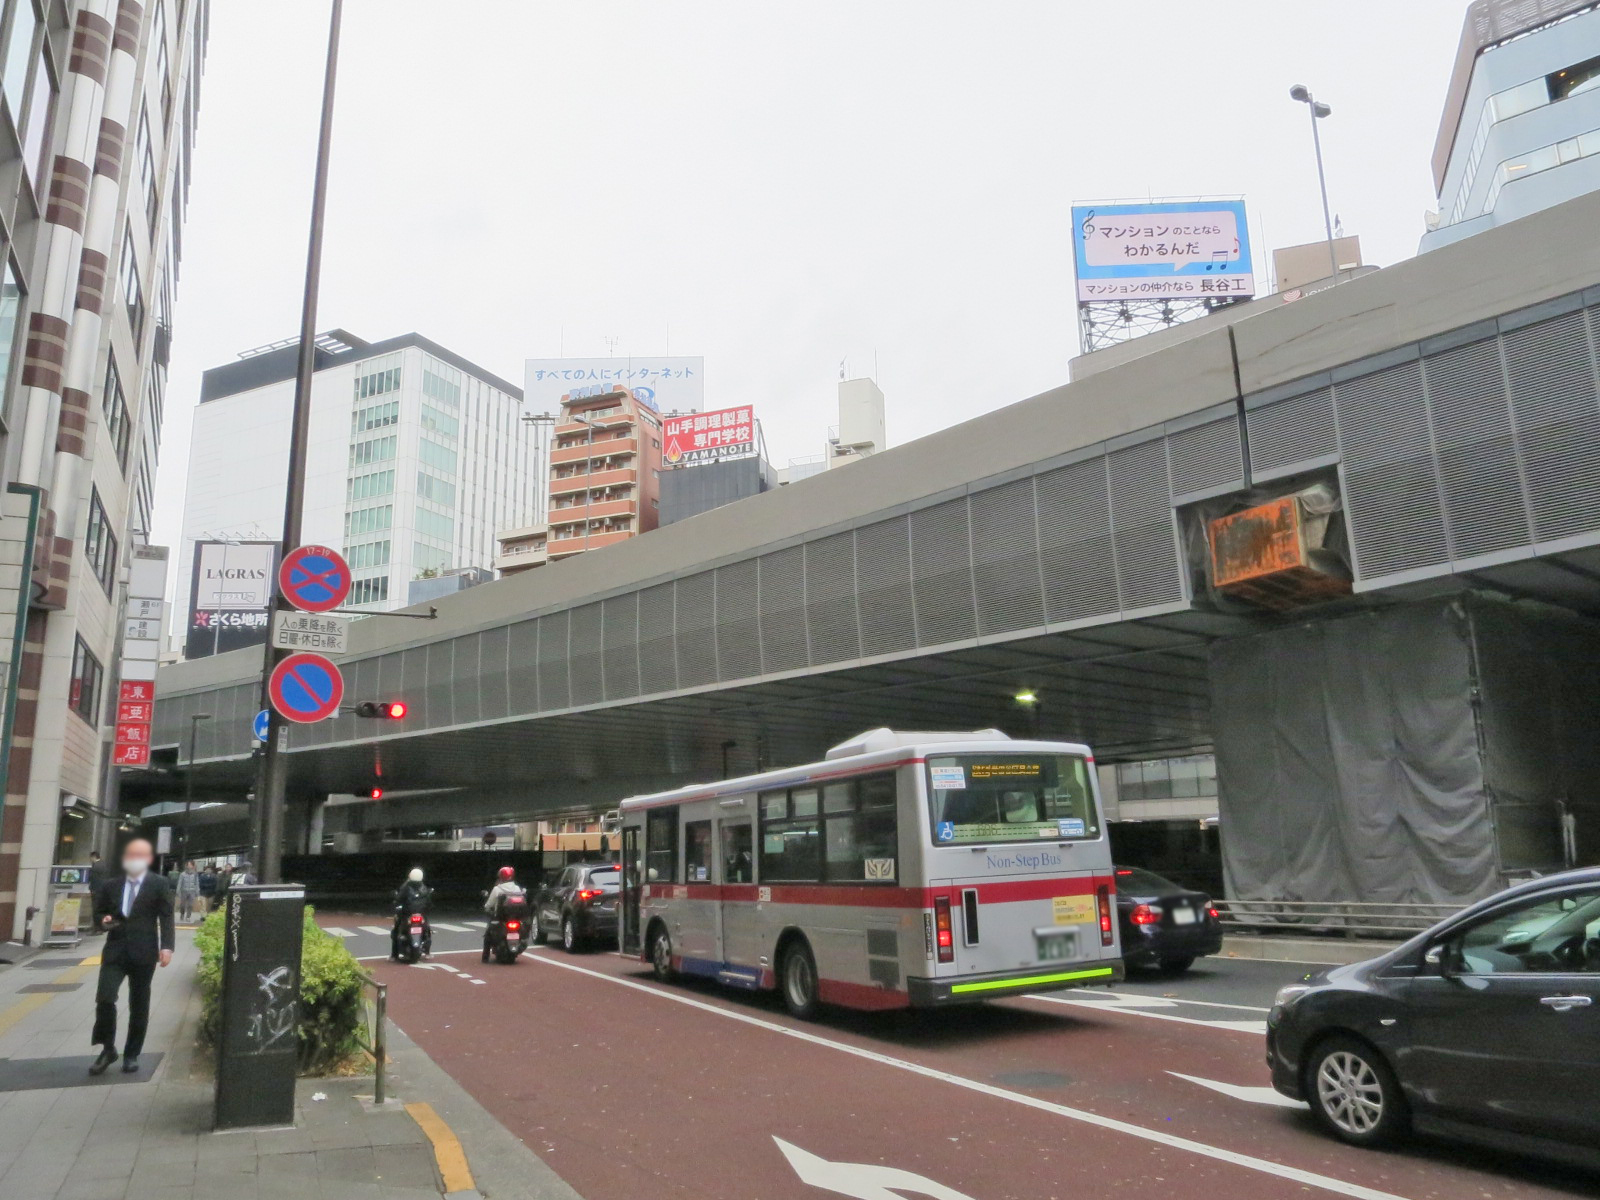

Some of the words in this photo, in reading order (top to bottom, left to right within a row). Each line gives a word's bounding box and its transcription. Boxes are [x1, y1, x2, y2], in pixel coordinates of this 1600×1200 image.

[1124, 241, 1200, 257] わかるんだ
[1200, 278, 1247, 293] 長谷工
[535, 367, 694, 381] すべての人にインターネット
[667, 409, 750, 437] 山手調理製菓
[694, 426, 750, 447] 専門学校
[683, 443, 751, 461] YAMANOTE
[206, 568, 265, 579] LAGRAS
[209, 612, 268, 626] さくら地所
[280, 616, 343, 633] 人の乗降を除く
[125, 686, 145, 760] 東亜飯店
[986, 853, 1040, 870] Non-Step
[1041, 852, 1062, 866] Bus
